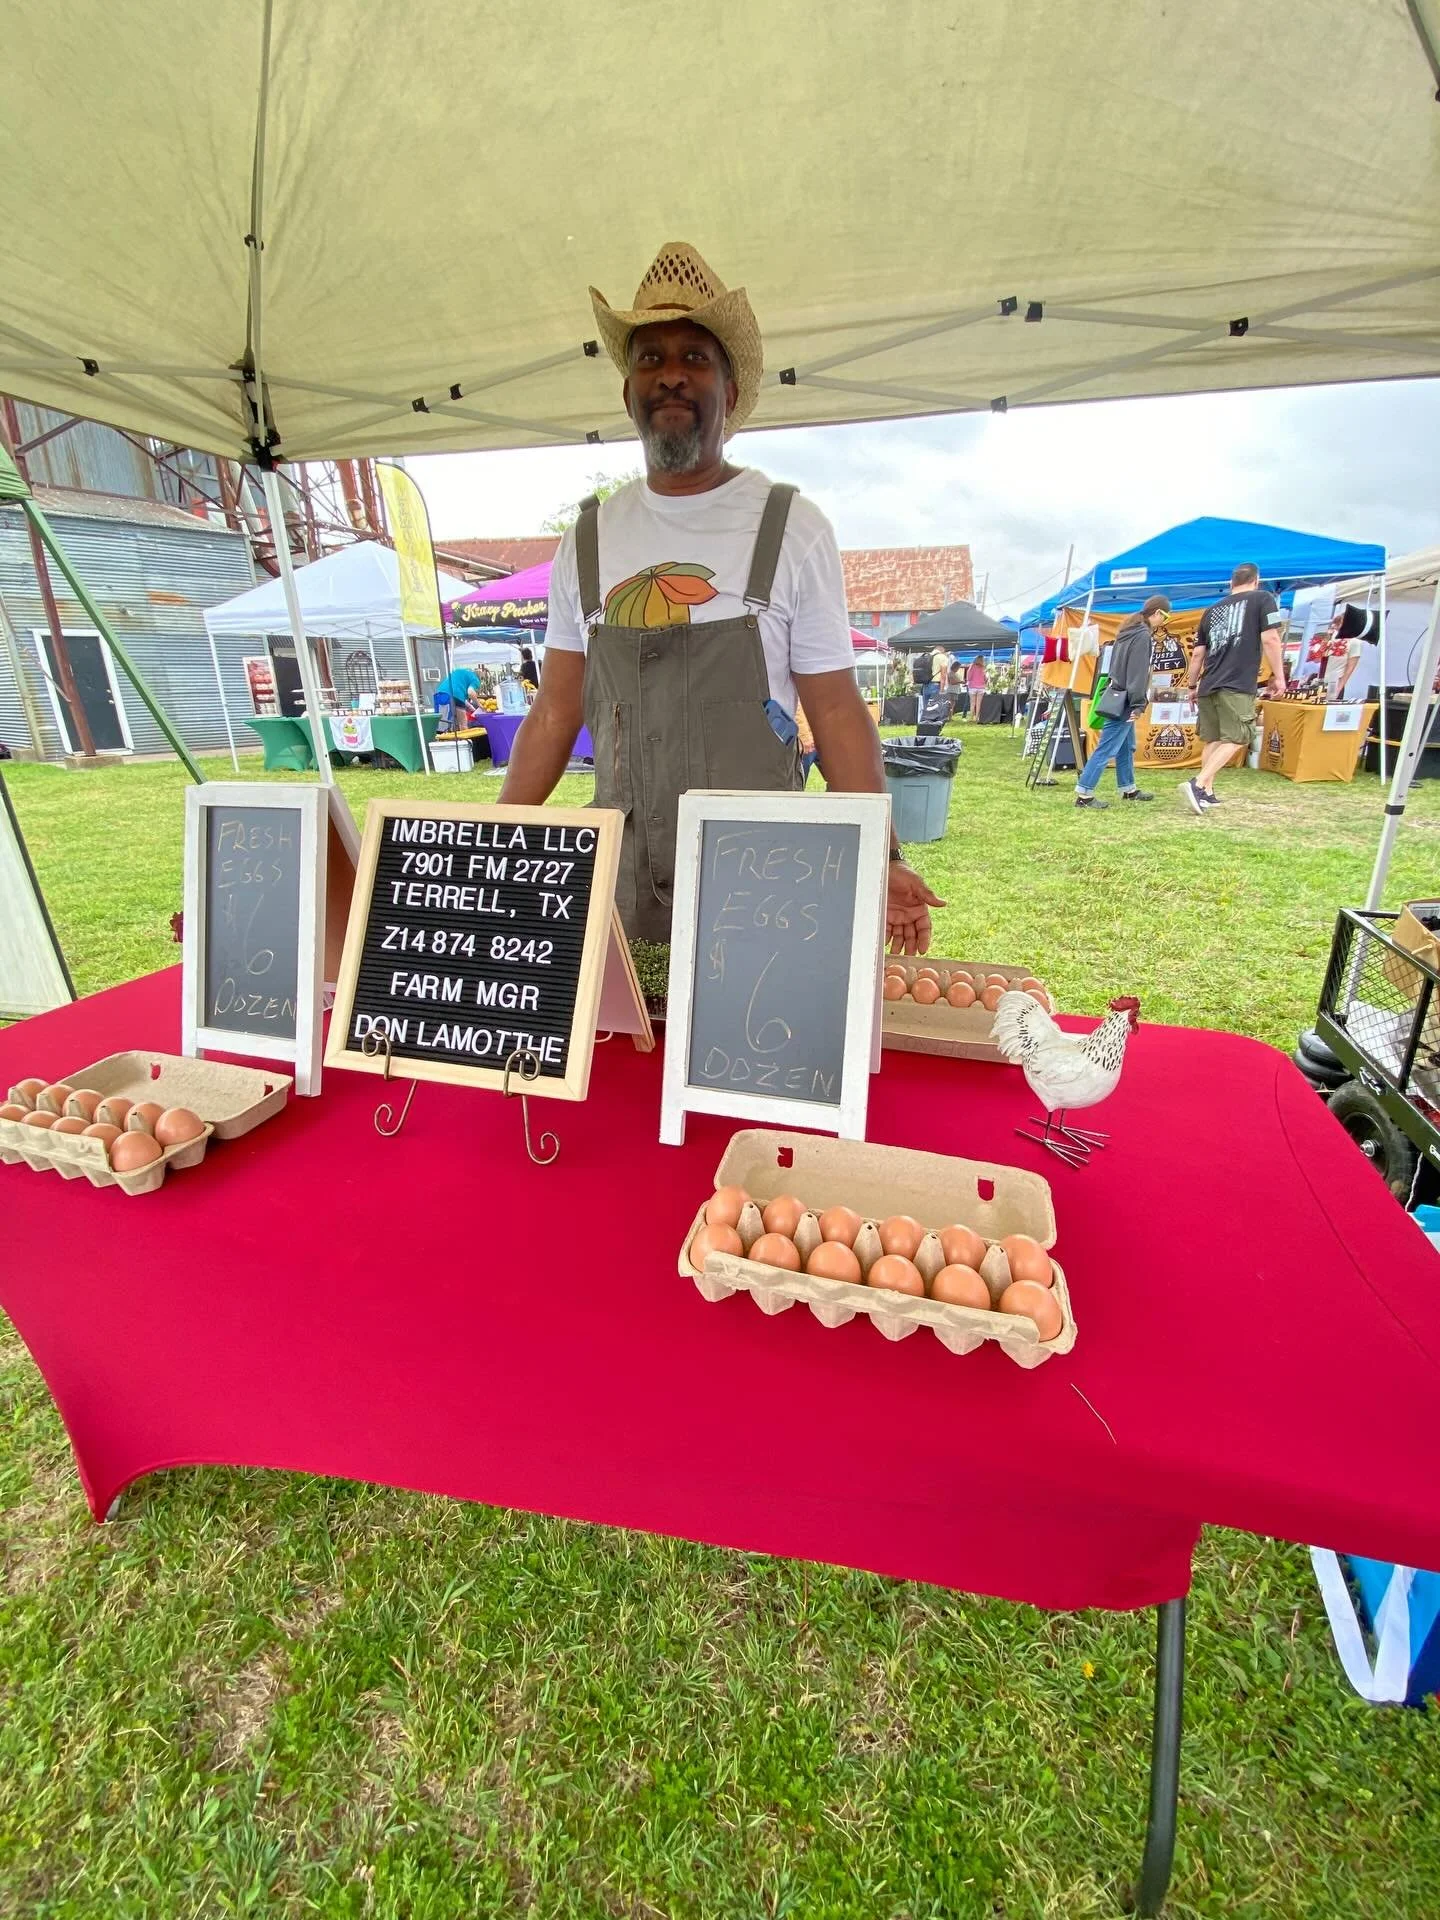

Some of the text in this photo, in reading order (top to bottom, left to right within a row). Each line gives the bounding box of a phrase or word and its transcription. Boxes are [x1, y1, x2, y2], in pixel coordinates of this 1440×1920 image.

[461, 602, 500, 623] Krazy
[1153, 661, 1181, 671] NEY
[217, 820, 293, 854] FRESH
[391, 818, 596, 854] IMBRELLA LLC
[218, 858, 283, 889] EGGS
[400, 851, 575, 885] 7901 FM 2727
[711, 829, 846, 885] FRESH
[390, 881, 574, 920] TERRELL, TX
[712, 891, 823, 941] EGGS
[432, 930, 476, 958] 874
[490, 936, 553, 965] 8242
[214, 977, 297, 1019] DOZEN
[390, 972, 540, 1011] FARM MGR
[354, 1014, 565, 1064] DON LAMOTTHE
[699, 1046, 835, 1097] DOZEN
